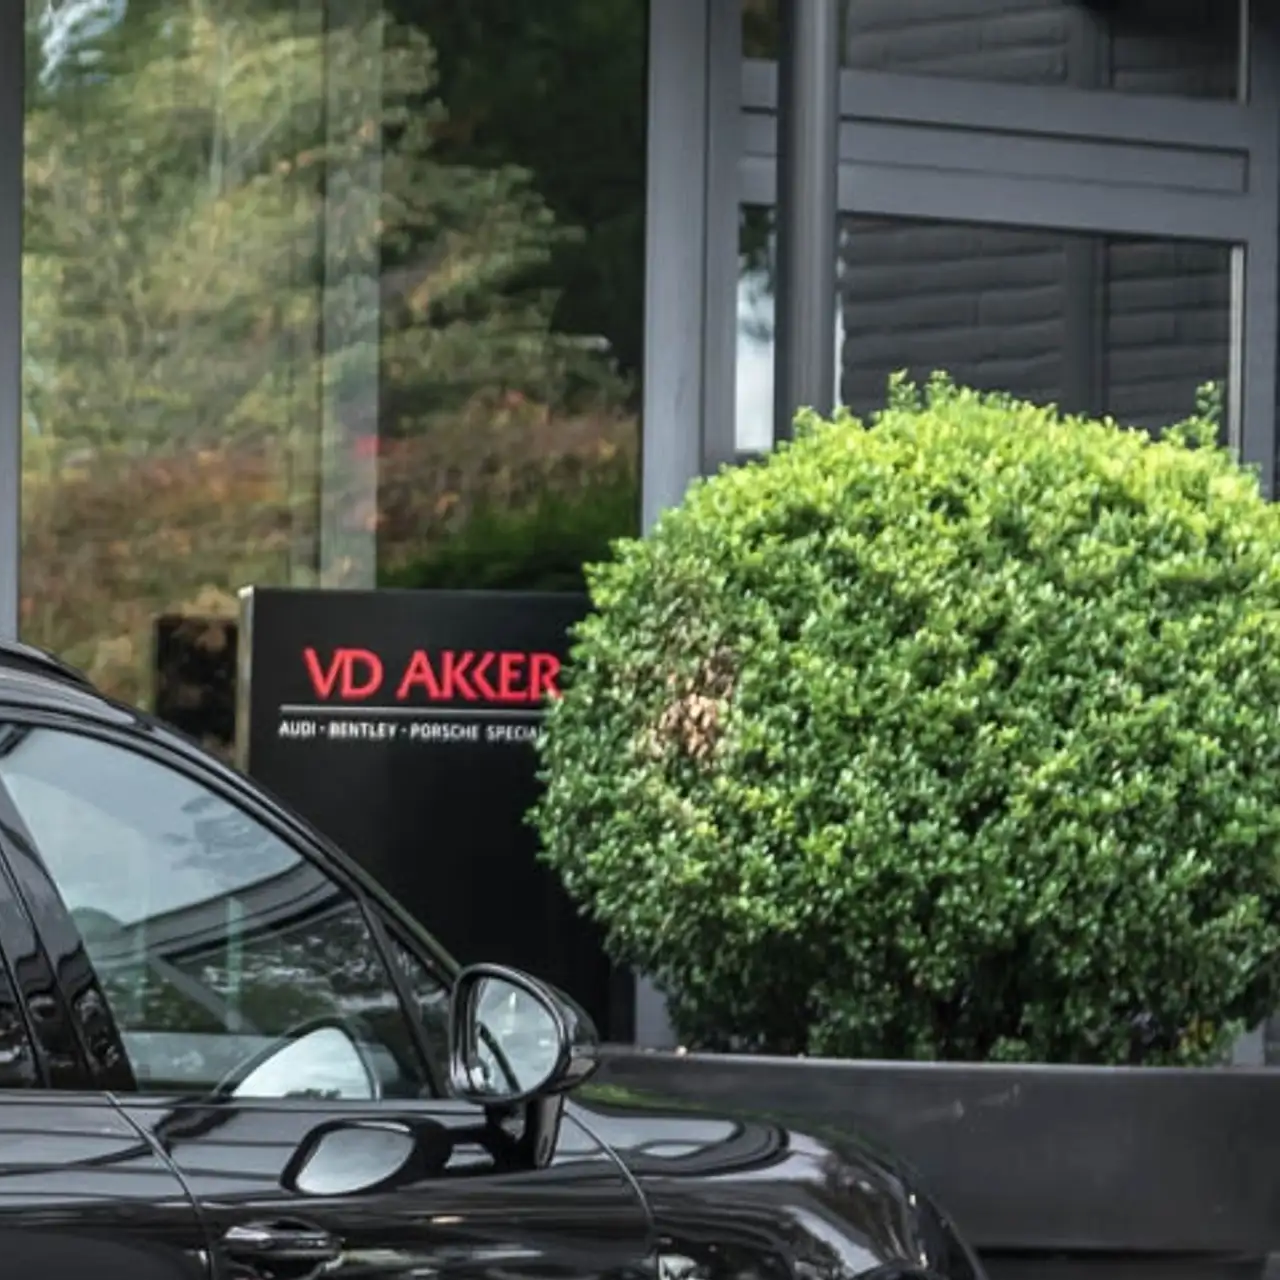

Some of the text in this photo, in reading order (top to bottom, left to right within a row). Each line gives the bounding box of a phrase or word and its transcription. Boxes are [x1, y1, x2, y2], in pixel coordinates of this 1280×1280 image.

[304, 648, 562, 701] VD AKKER
[278, 720, 316, 737] AUDI
[328, 722, 396, 739] BENTLEY
[410, 724, 478, 741] PORSCHE
